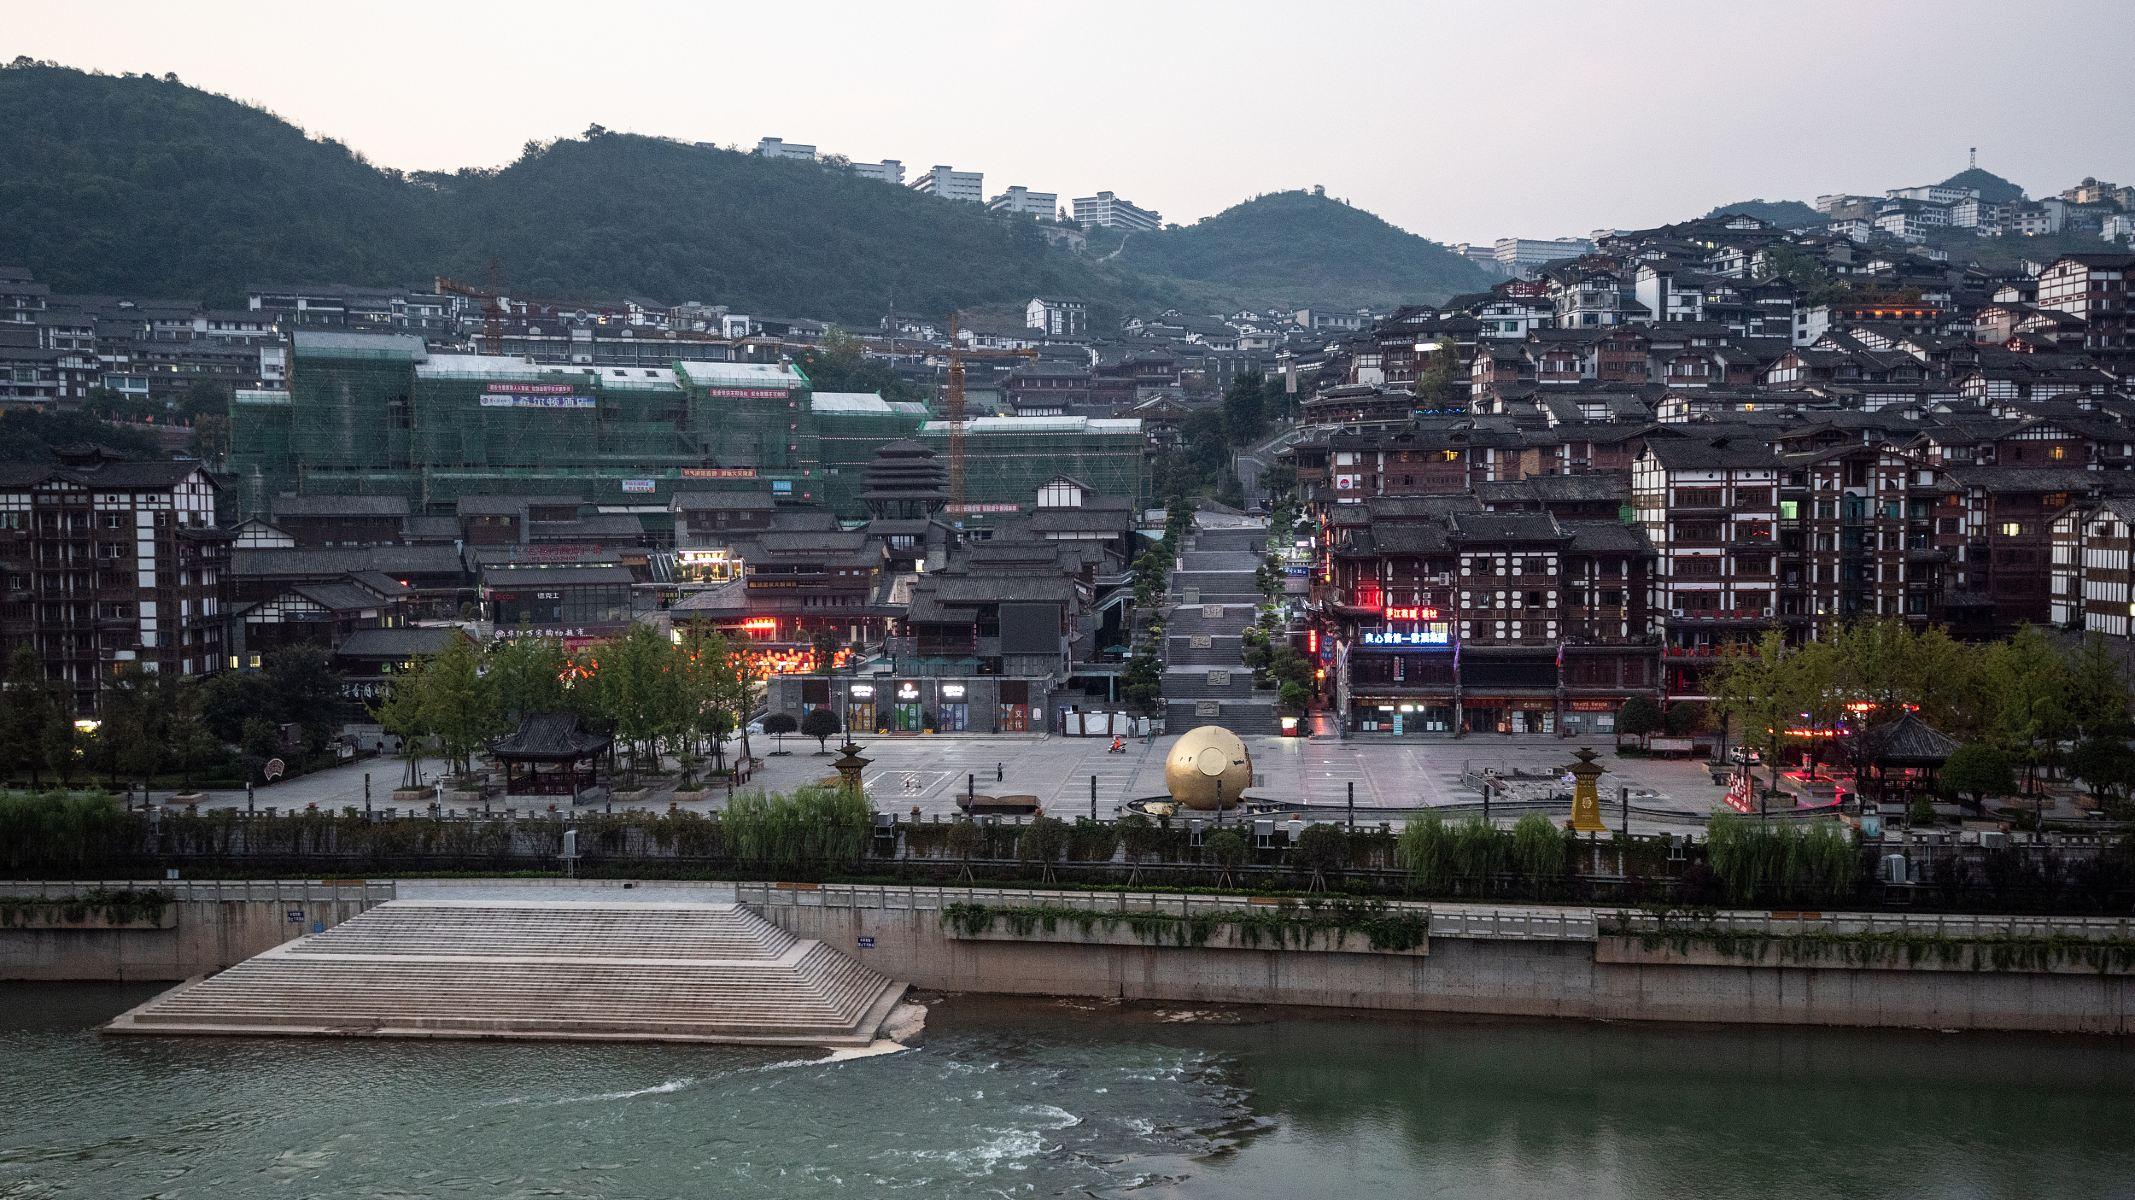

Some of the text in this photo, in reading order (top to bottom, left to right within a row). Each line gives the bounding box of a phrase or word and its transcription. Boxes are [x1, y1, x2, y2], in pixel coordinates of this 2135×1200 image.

[520, 396, 588, 407] 希尔顿酒店
[1015, 710, 1023, 728] 文化
